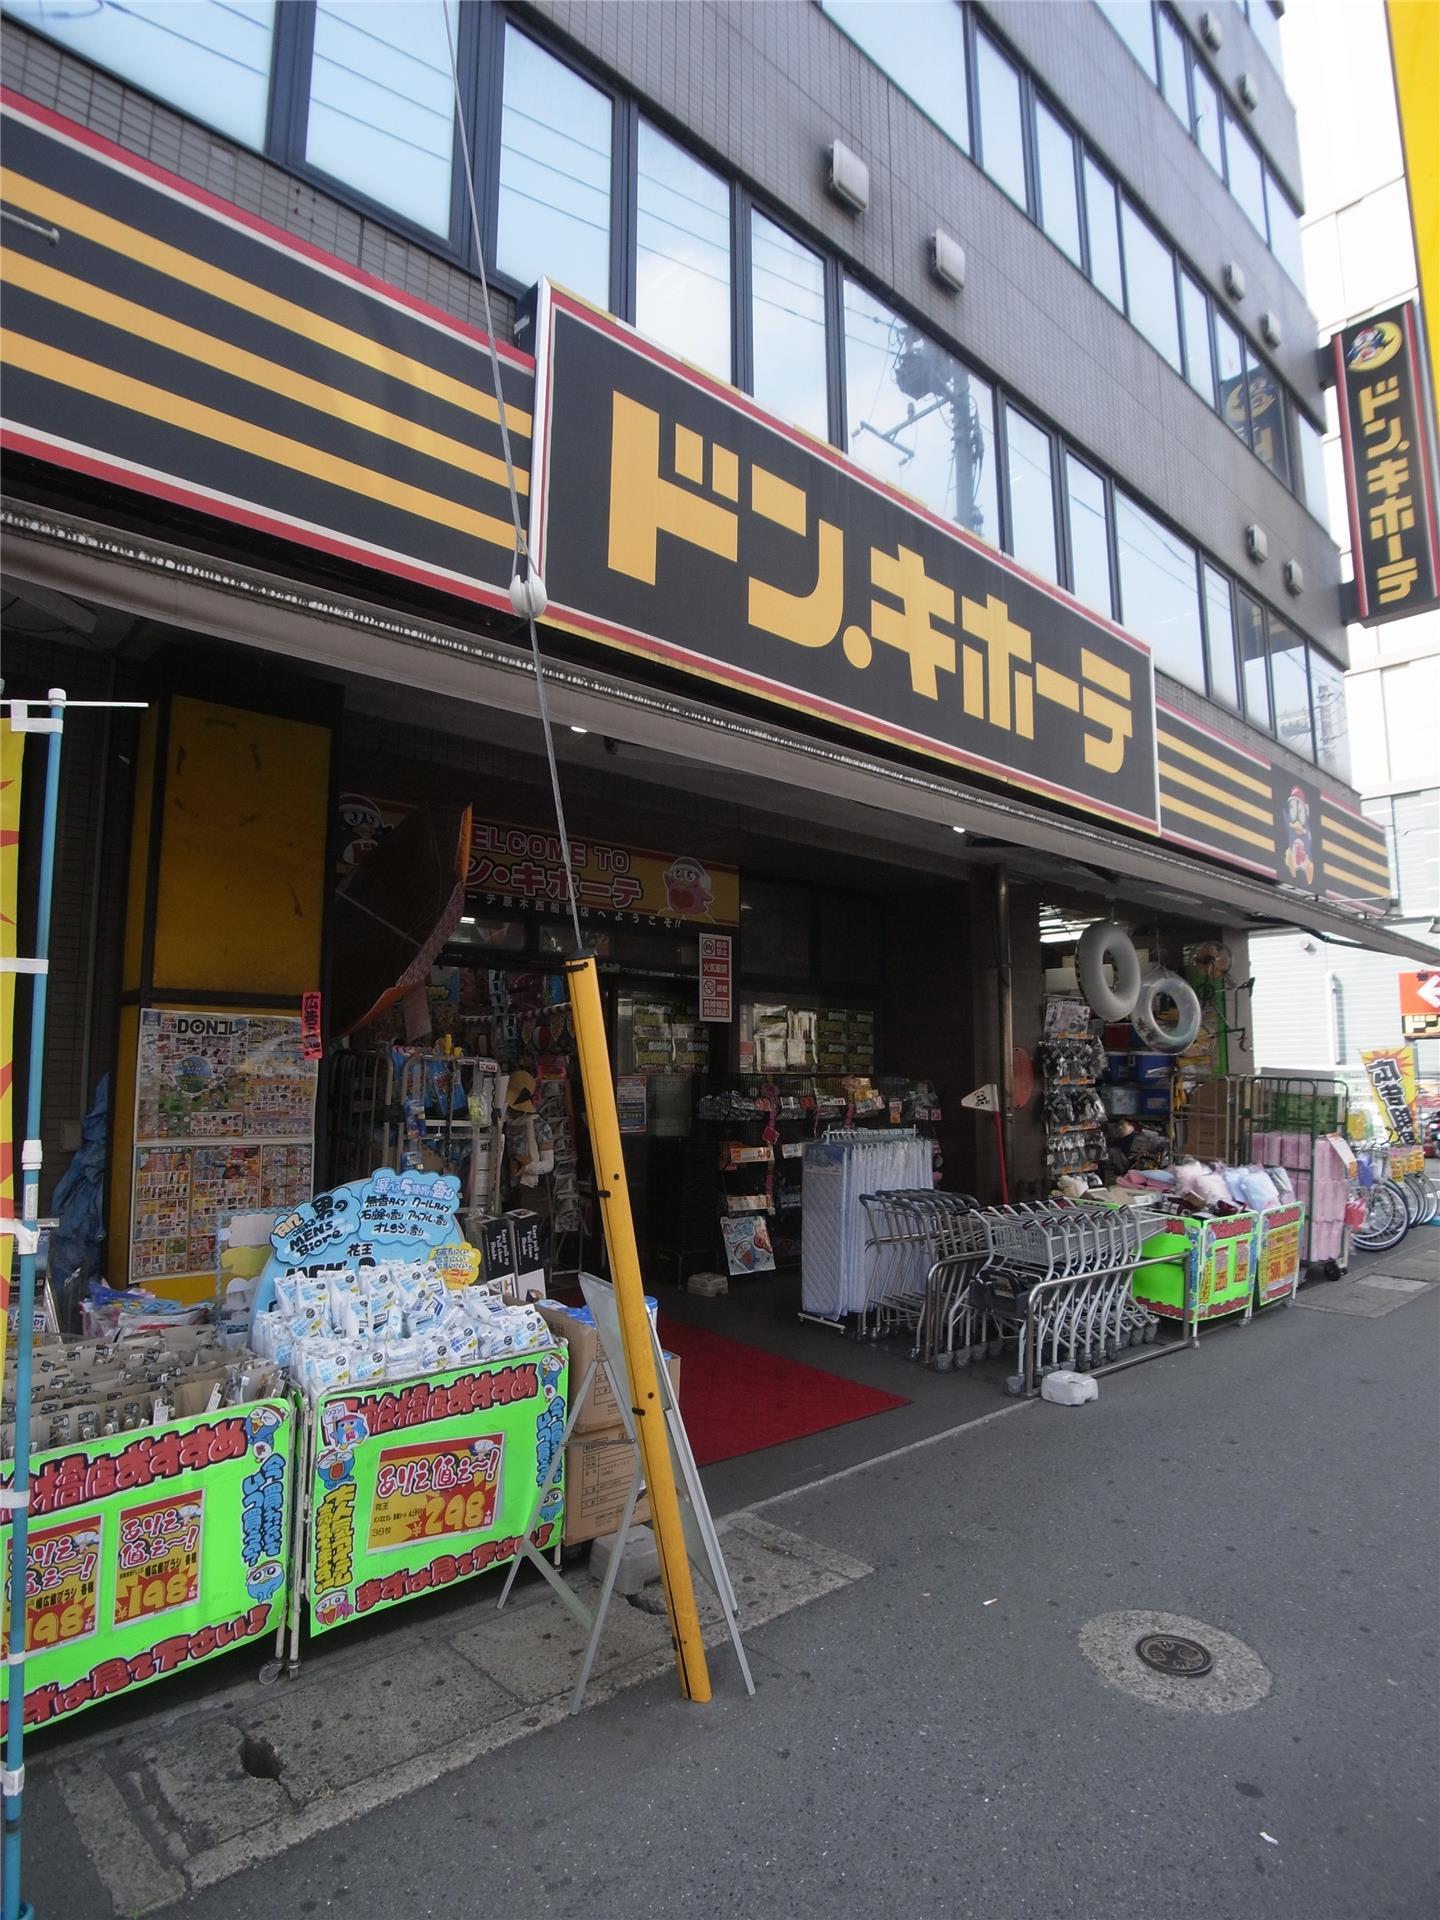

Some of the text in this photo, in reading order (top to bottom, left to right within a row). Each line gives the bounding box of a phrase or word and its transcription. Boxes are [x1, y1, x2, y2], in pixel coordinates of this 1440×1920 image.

[471, 822, 630, 874] ELCOME TO
[465, 856, 642, 909] ン・キホーテ
[346, 1243, 373, 1257] 花王
